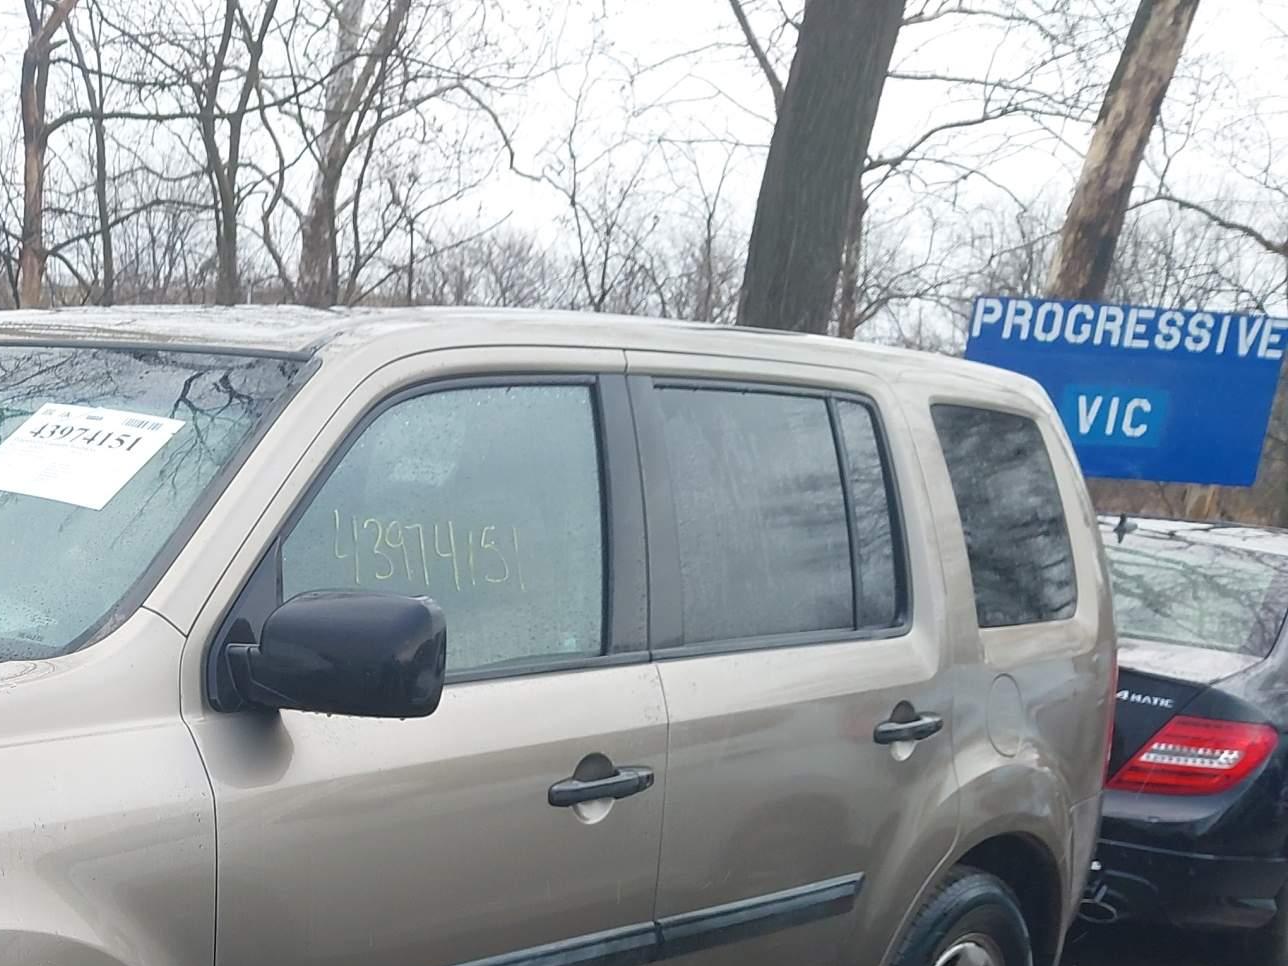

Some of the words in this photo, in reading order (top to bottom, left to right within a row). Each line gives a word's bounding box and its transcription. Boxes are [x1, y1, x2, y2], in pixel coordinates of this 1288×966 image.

[971, 298, 1288, 360] PROGRESSIVE
[29, 423, 143, 452] 43974151
[1077, 394, 1152, 438] VIC
[332, 508, 527, 593] 43974151
